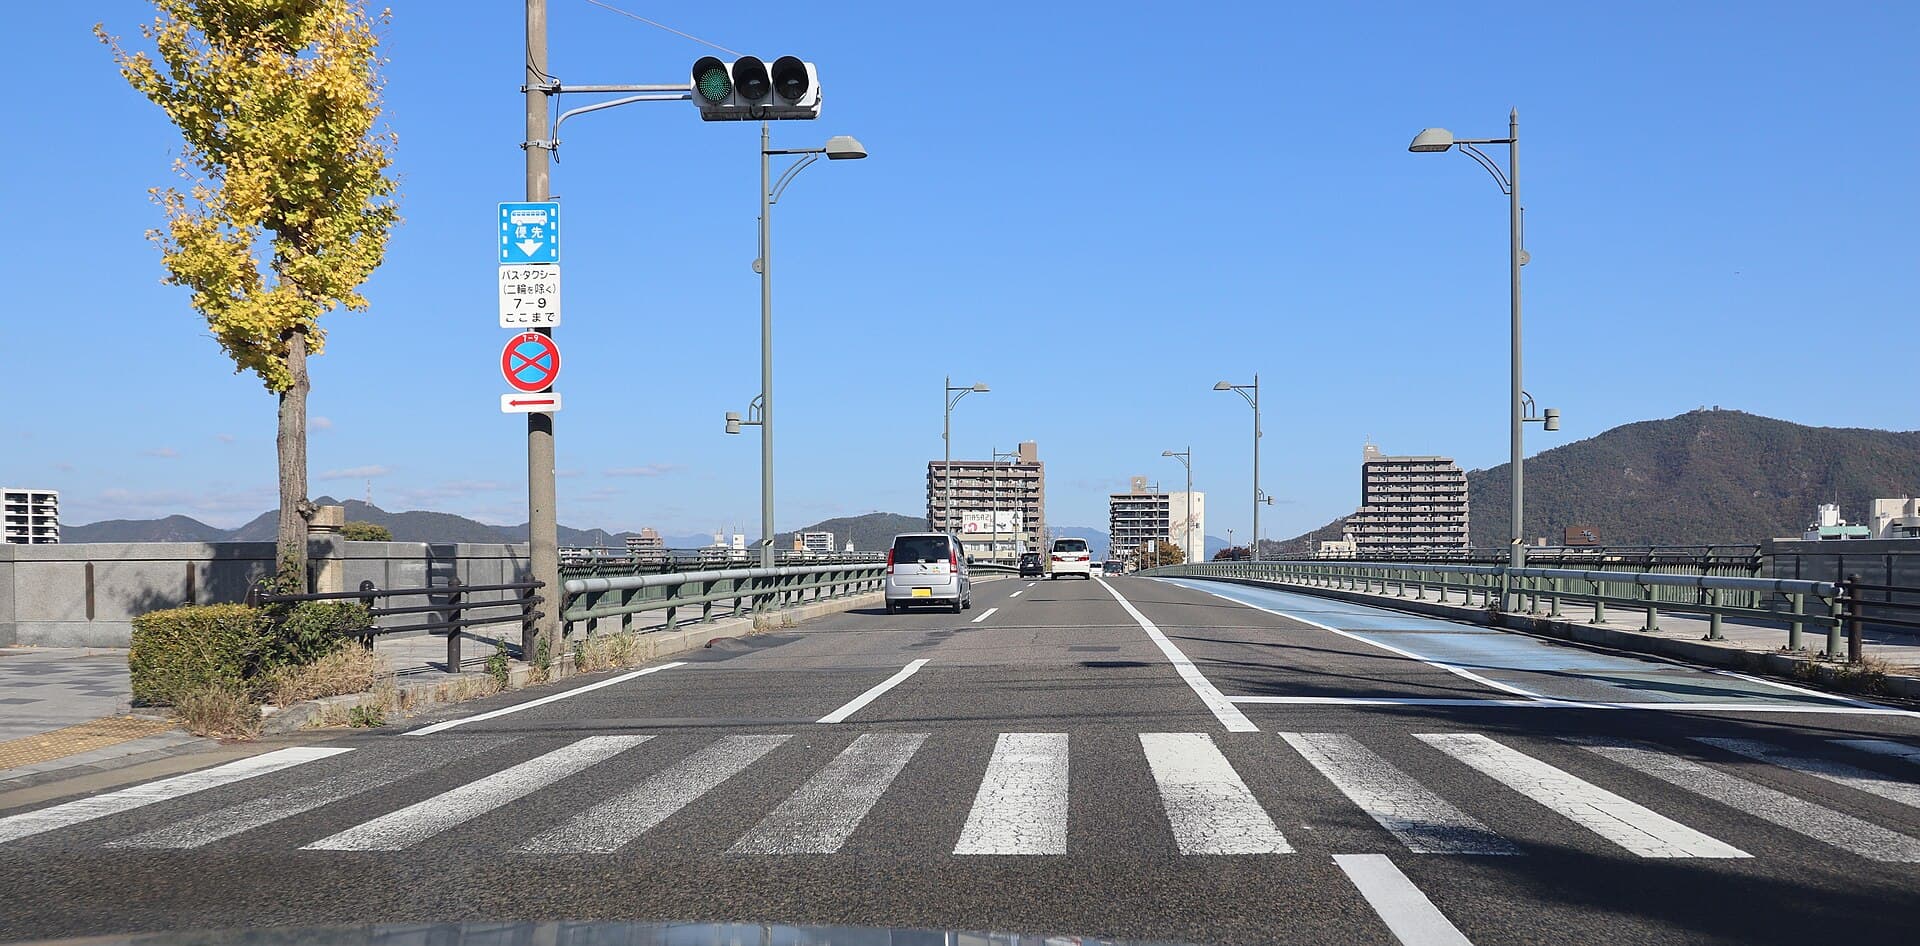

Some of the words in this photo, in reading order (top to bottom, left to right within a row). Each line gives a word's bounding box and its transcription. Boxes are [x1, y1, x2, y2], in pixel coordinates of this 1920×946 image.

[515, 226, 544, 239] 優先
[505, 312, 555, 322] ここまで
